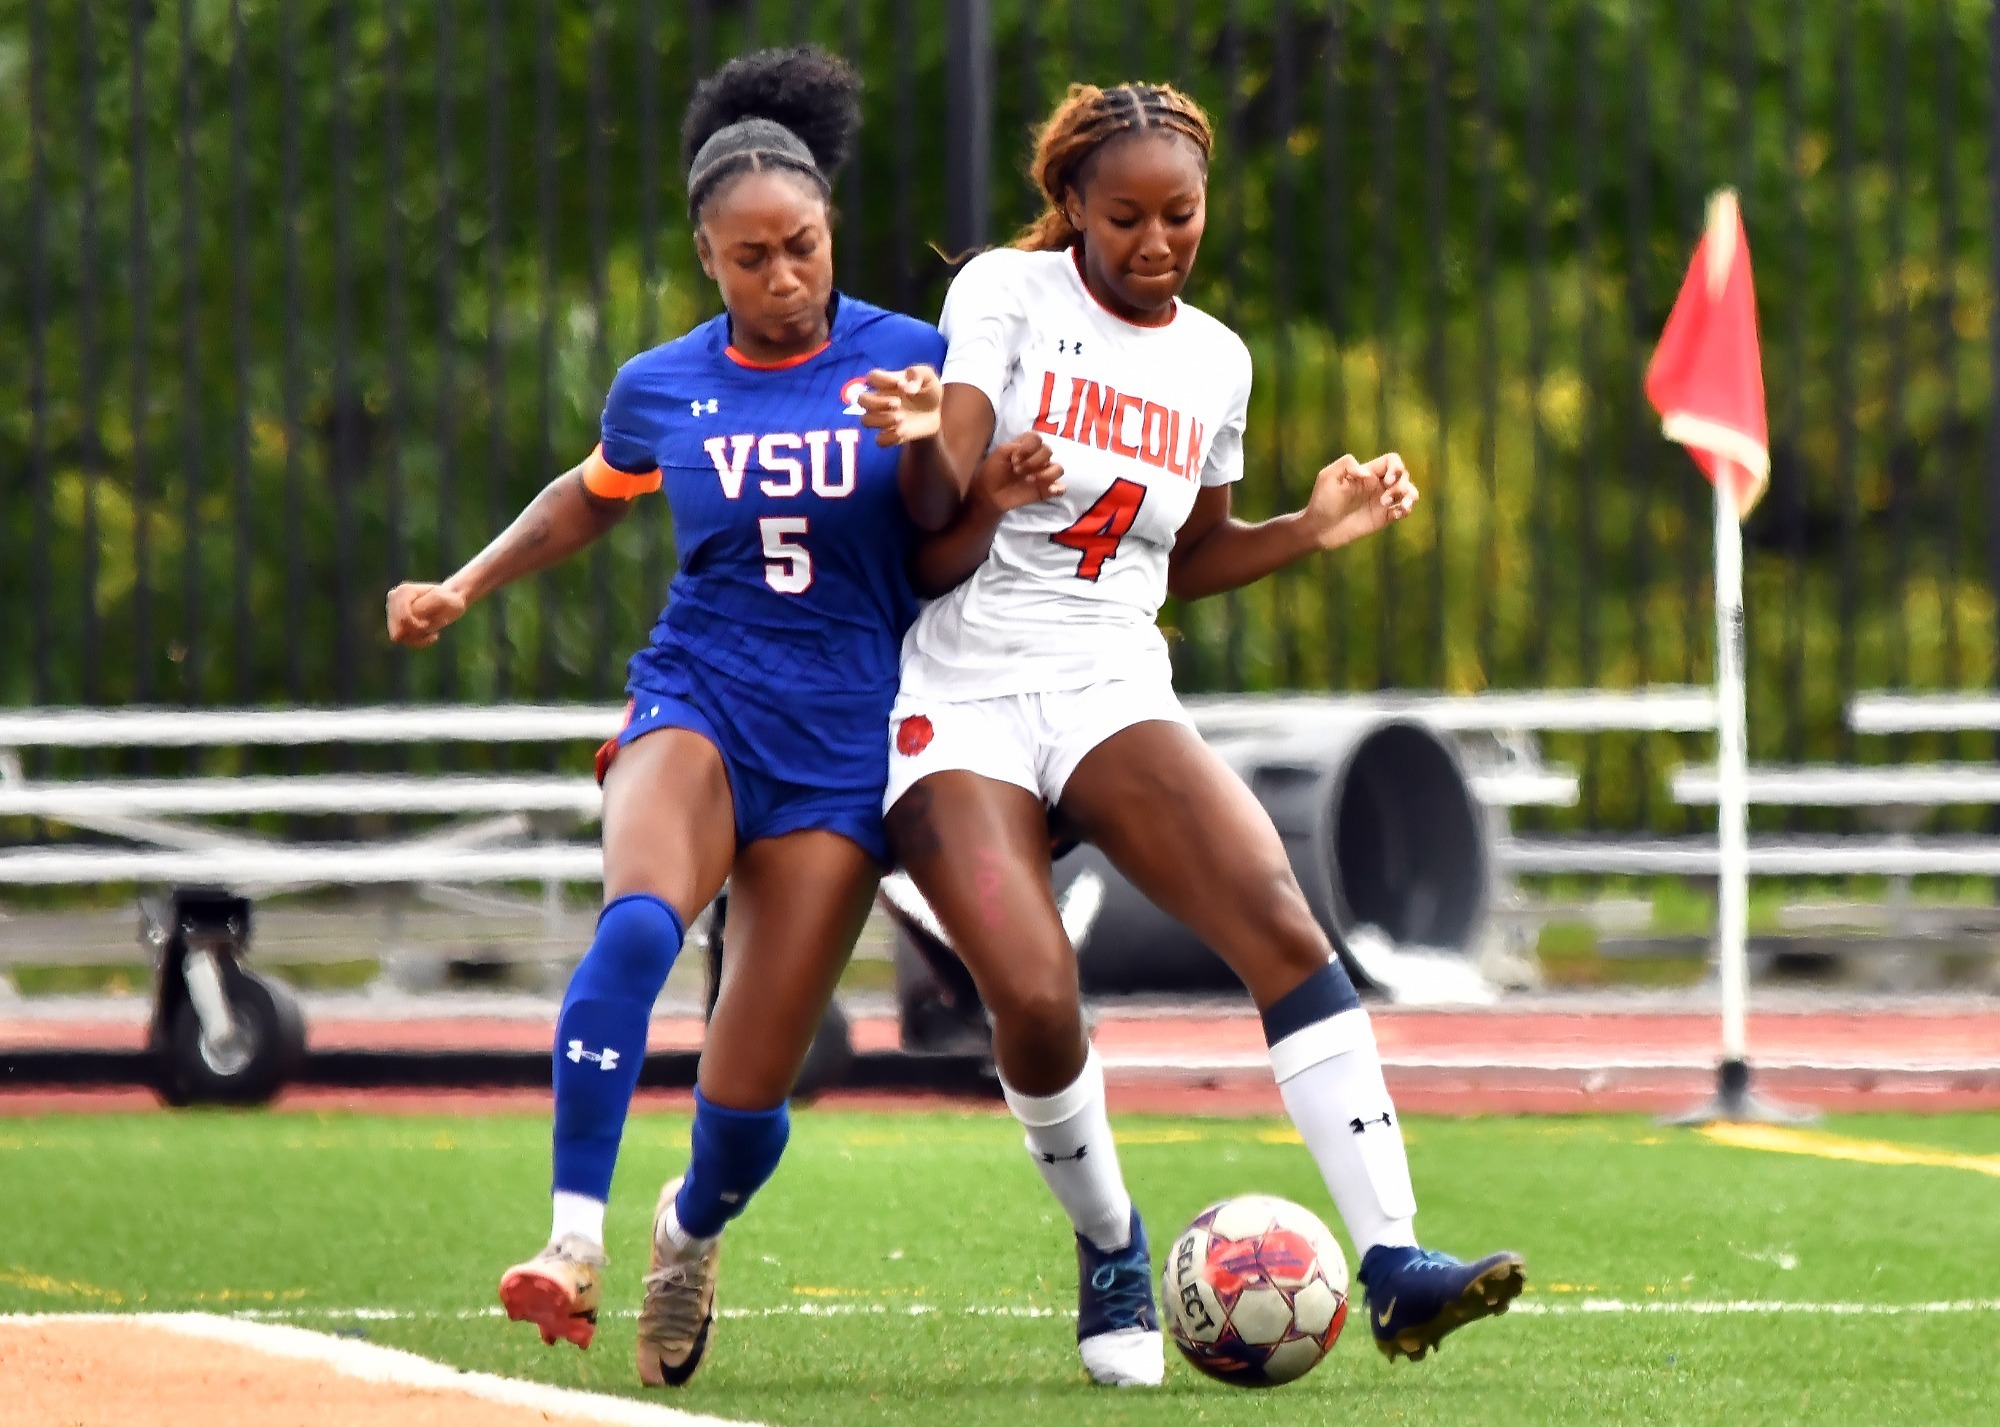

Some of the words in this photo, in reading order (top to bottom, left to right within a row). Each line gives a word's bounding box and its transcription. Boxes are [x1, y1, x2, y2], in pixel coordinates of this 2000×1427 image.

[704, 428, 860, 499] VSU
[1033, 370, 1204, 484] LINCOLN
[758, 516, 812, 595] 5
[1050, 477, 1147, 582] 4
[1176, 1235, 1215, 1332] SELECT
